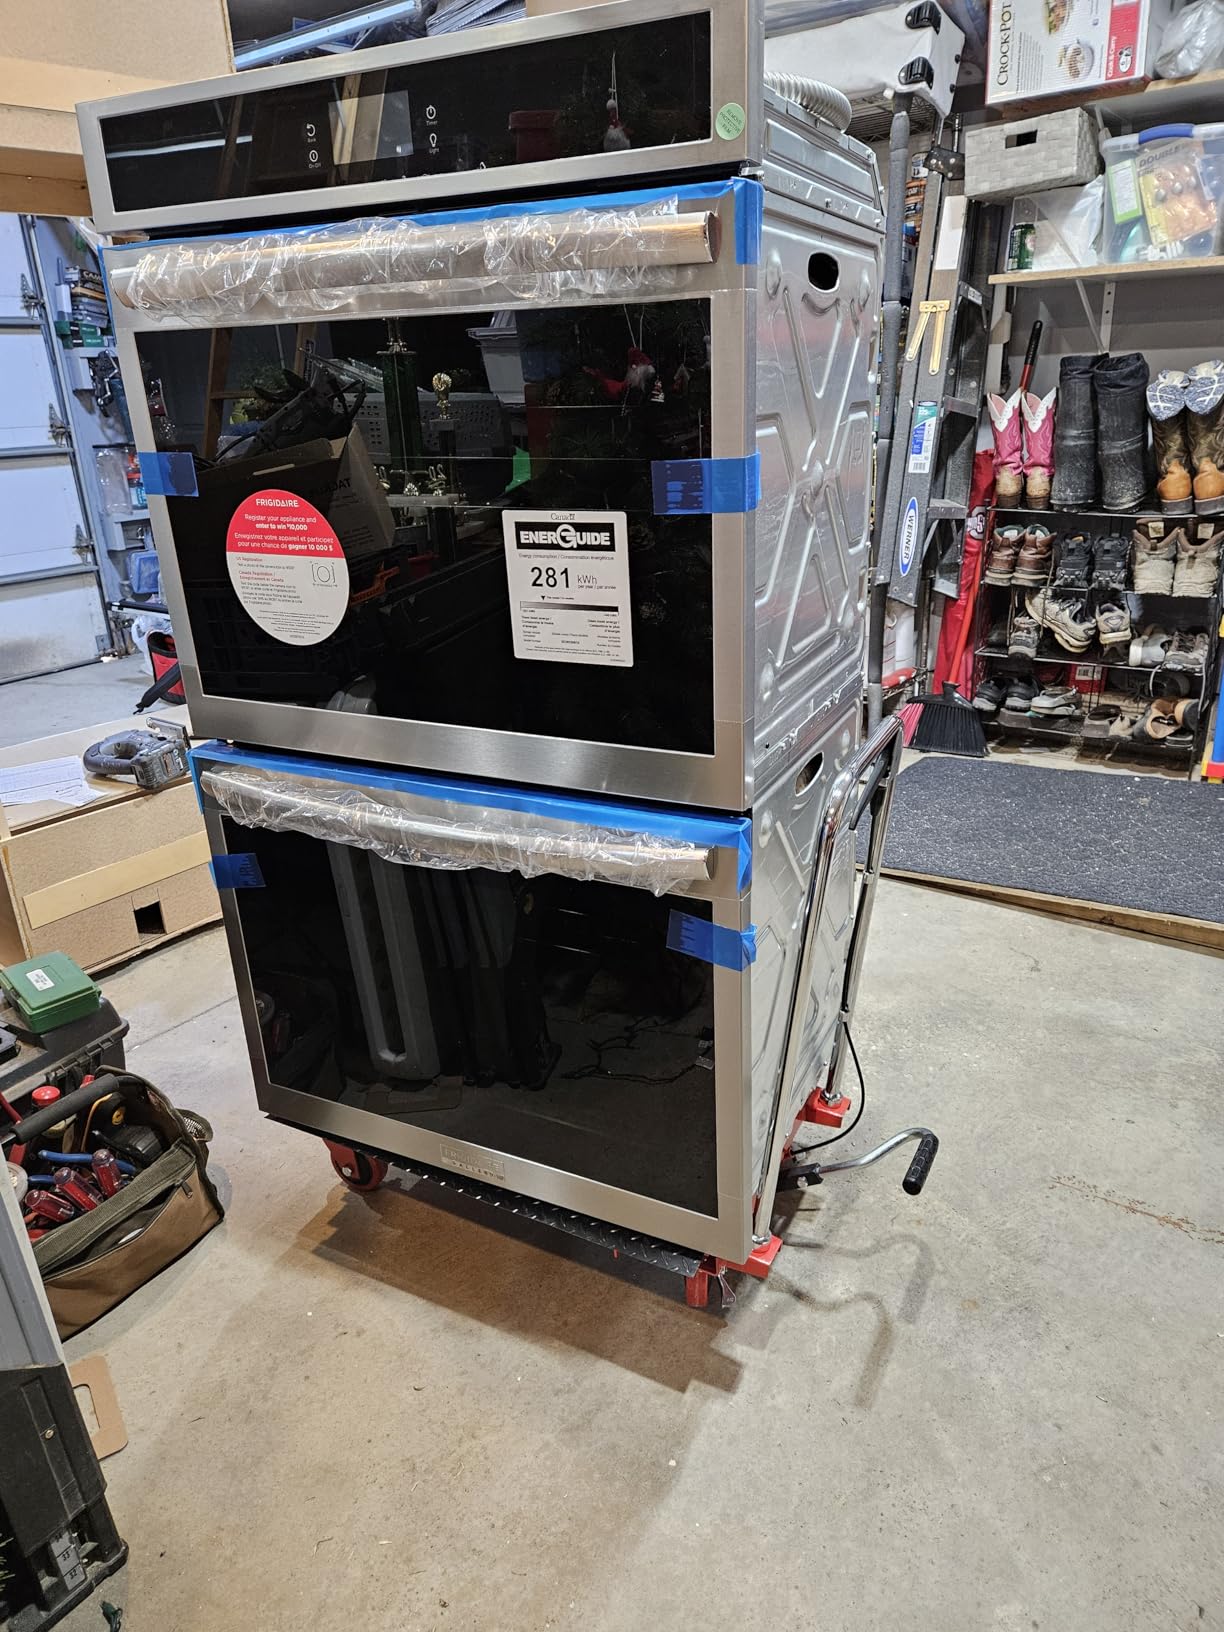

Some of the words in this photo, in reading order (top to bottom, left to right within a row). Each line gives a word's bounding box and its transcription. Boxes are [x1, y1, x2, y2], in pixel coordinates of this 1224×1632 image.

[255, 498, 300, 508] FRIGIDAIRE
[244, 513, 266, 522] Register
[280, 515, 306, 523] appliance
[550, 512, 576, 521] Canada
[234, 532, 263, 540] Enregistrez
[307, 536, 334, 544] participez
[519, 523, 611, 549] ENERGUIDE
[903, 514, 915, 560] WERNER
[329, 544, 334, 552] $
[530, 566, 570, 589] 281
[577, 574, 598, 585] kWh
